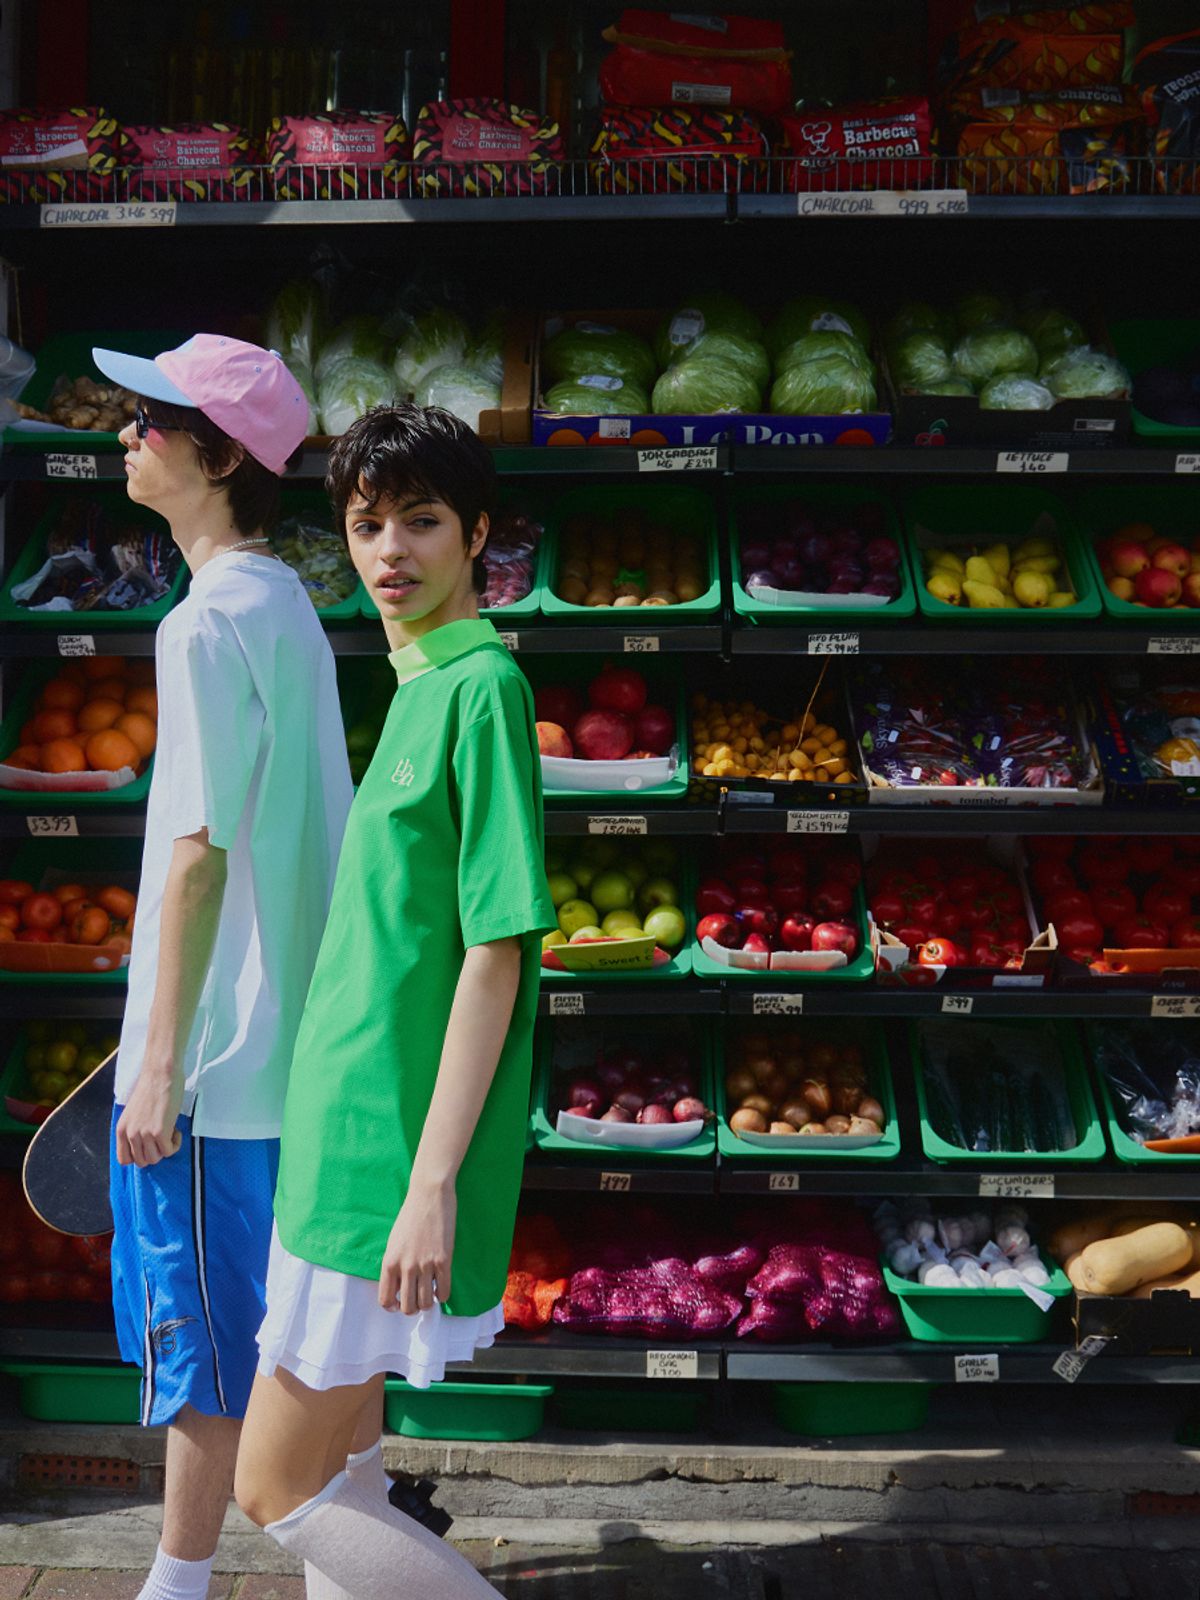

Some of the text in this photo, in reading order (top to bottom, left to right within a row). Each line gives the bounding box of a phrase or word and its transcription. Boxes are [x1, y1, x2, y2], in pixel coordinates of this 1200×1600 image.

[843, 126, 918, 146] Barbecue
[177, 146, 221, 155] Barbecue
[332, 143, 377, 153] Charcoal
[479, 141, 521, 150] Charcoal
[846, 138, 921, 163] Charcoal
[177, 156, 221, 165] Charcoal
[802, 197, 874, 214] CHARCOAL
[900, 198, 929, 215] 999
[45, 208, 110, 224] CHARCOAL
[599, 956, 641, 967] Sweet
[771, 1175, 795, 1188] 169
[979, 1176, 1056, 1186] CUCUMBERS
[957, 1357, 989, 1368] GARLIC
